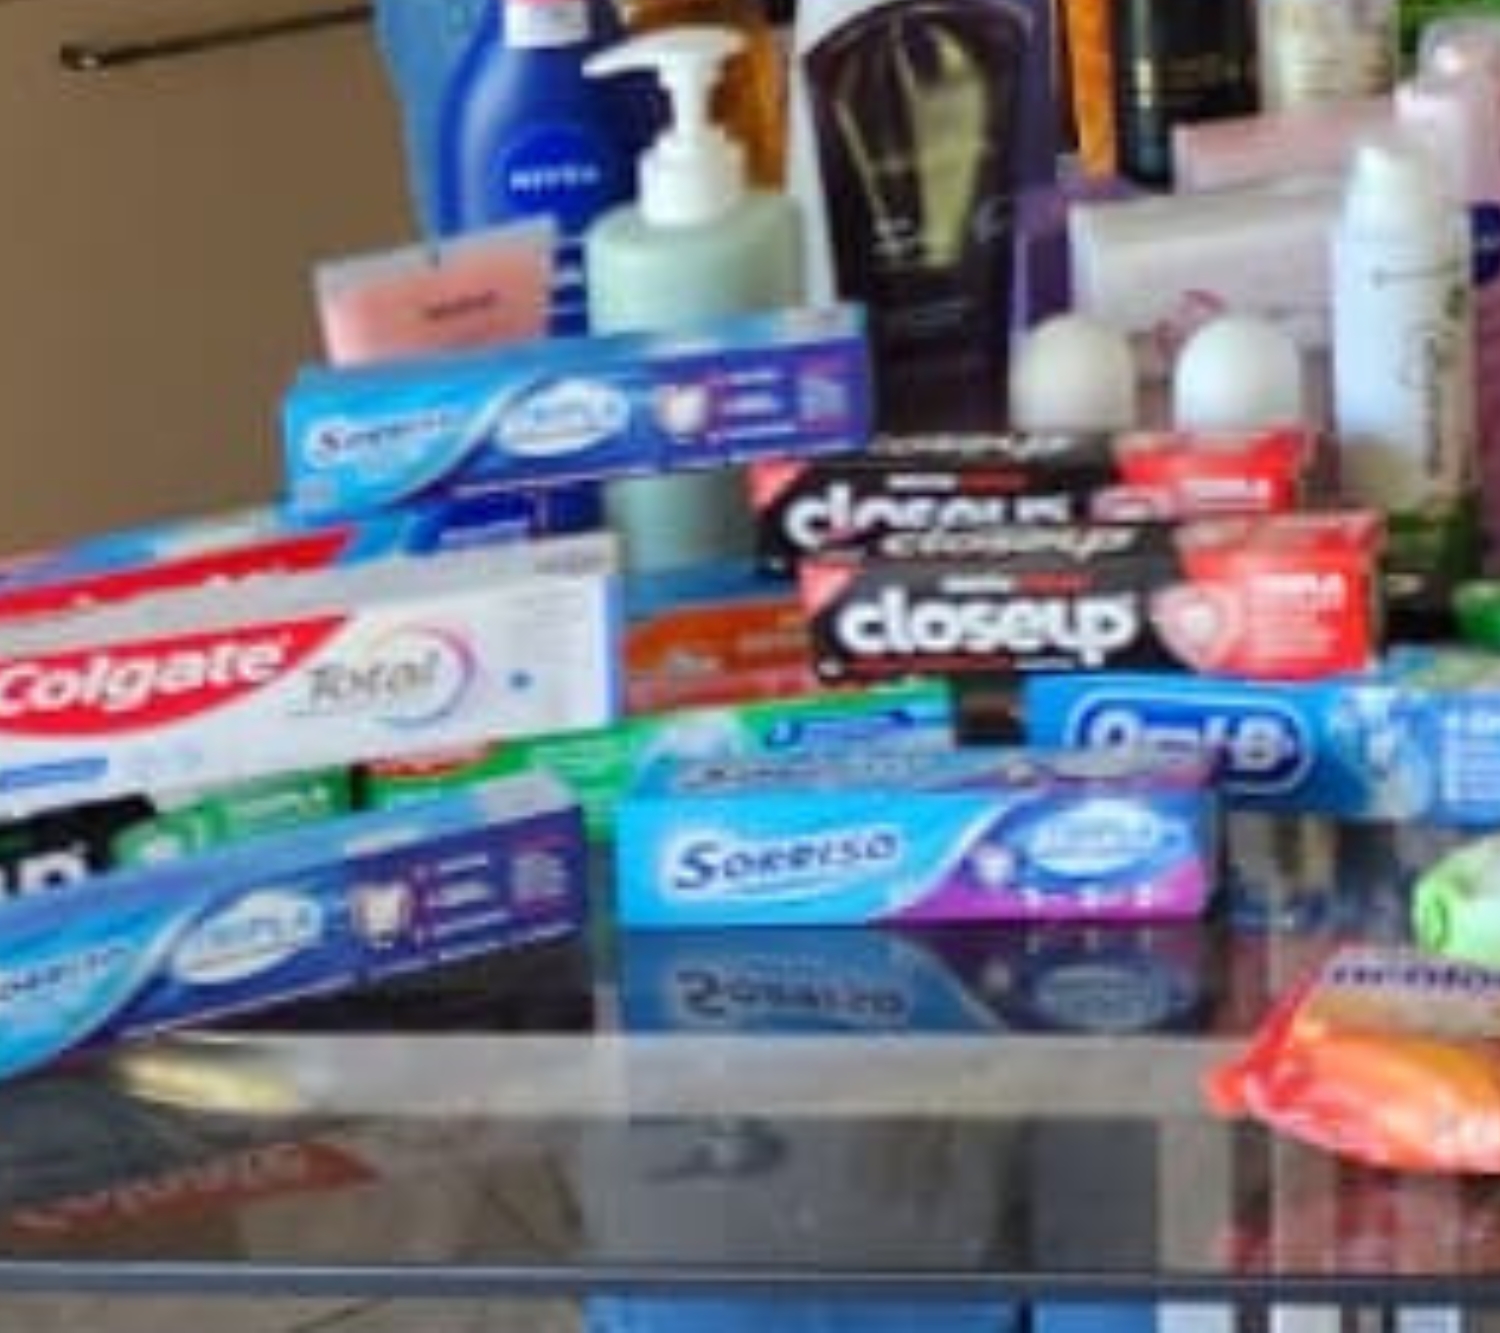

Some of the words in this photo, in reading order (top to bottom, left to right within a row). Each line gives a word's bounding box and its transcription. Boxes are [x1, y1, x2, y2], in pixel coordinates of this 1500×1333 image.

[834, 587, 1142, 669] closeup
[0, 635, 292, 712] Colgate
[308, 649, 440, 709] Total
